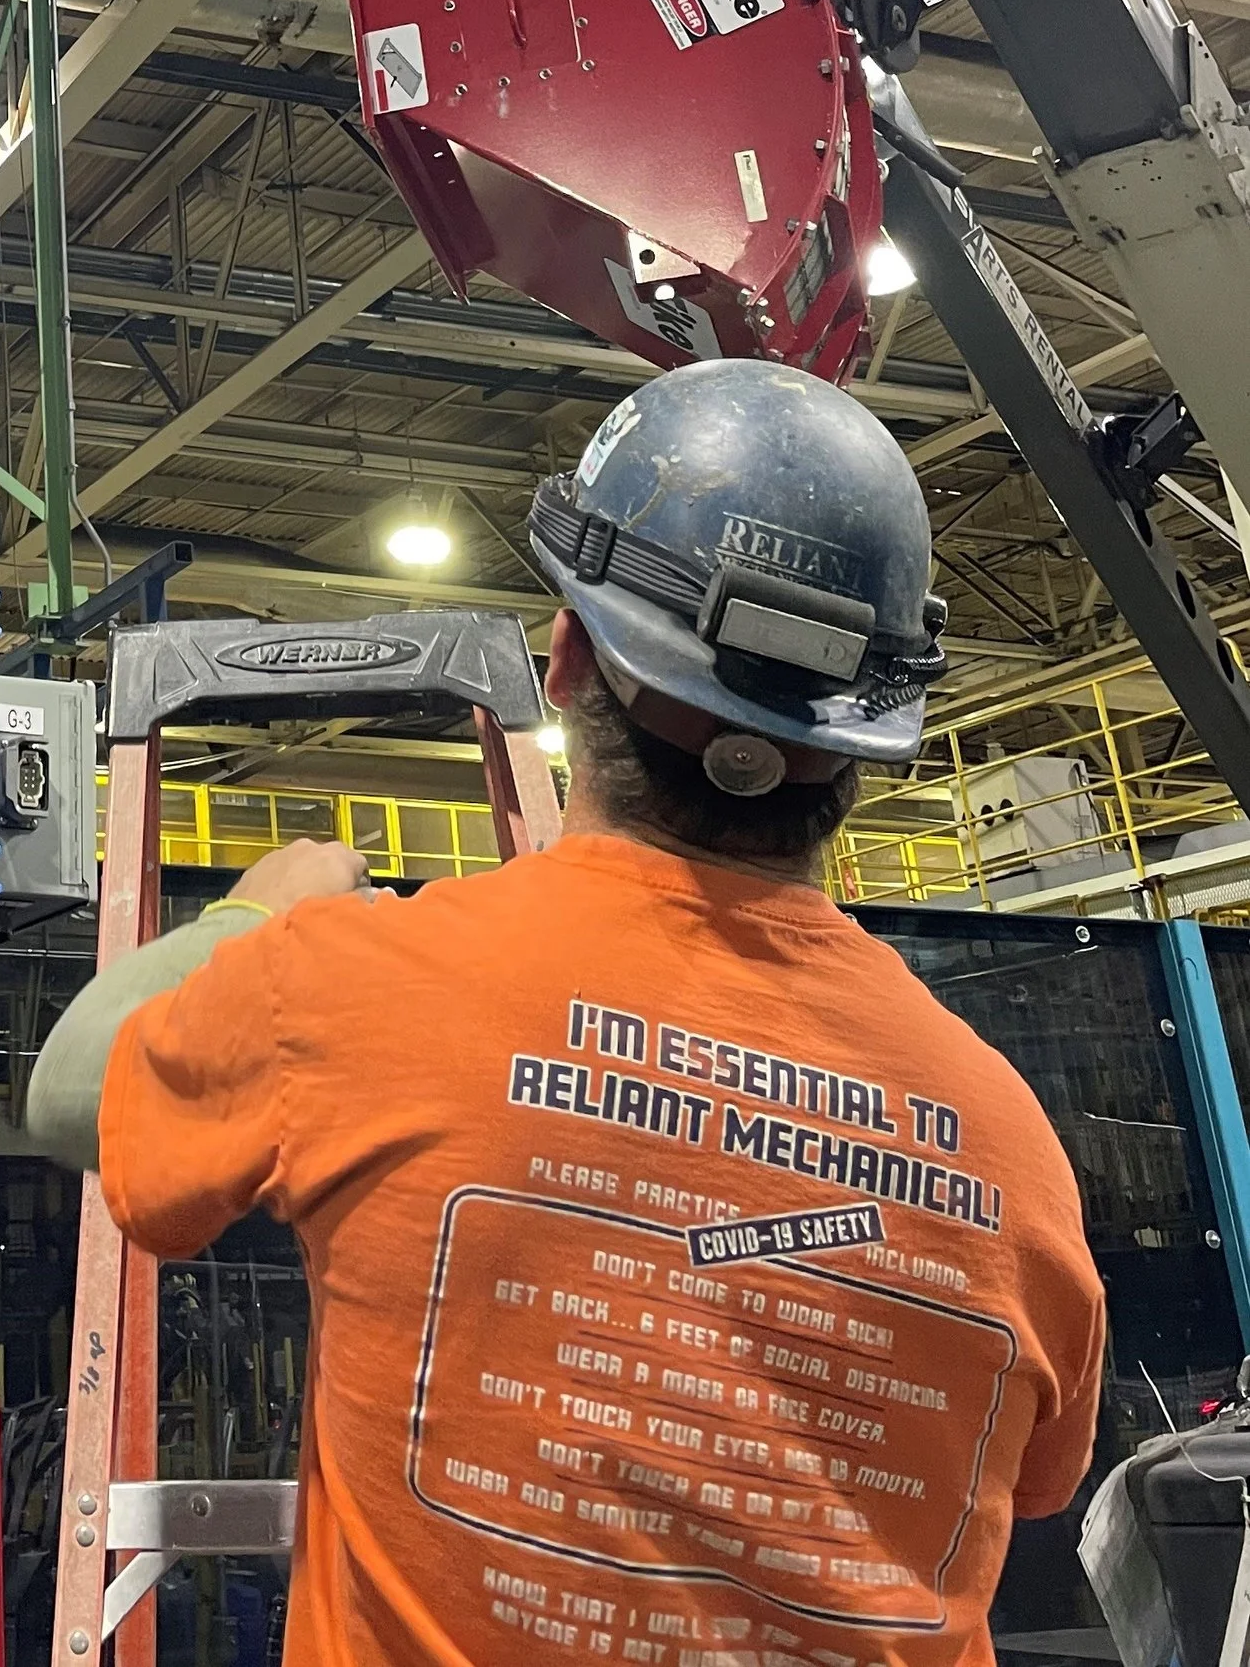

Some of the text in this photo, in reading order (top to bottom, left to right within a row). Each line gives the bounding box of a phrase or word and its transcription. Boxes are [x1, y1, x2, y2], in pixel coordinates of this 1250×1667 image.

[964, 232, 1088, 424] ART'S RENTAL
[7, 708, 33, 730] G-3
[567, 998, 960, 1155] I'M ESSENTIAL TO
[507, 1053, 1001, 1235] RELIANT MECHANICAL!
[528, 1156, 620, 1196] PLEASE
[699, 1210, 872, 1262] COVID-19 SAFETY
[495, 1278, 540, 1307] GET
[666, 1317, 721, 1351] FEET
[729, 1336, 754, 1359] OF
[763, 1343, 831, 1382] SOCIAL
[592, 1249, 657, 1284] DON'T
[667, 1269, 729, 1305] COME
[741, 1288, 766, 1314] TO
[776, 1299, 836, 1334] WORK
[556, 1342, 888, 1445] WEAR A MASK OR FACE COVER.
[480, 1371, 547, 1410] DON'T
[559, 1393, 633, 1432] TOUCH
[646, 1416, 705, 1451] YOUR
[855, 1464, 927, 1500] MOUTH.
[537, 1437, 605, 1475] DON'T
[618, 1459, 690, 1498] TOUCH
[700, 1482, 735, 1510] ME
[445, 1456, 509, 1496] WASH
[520, 1481, 565, 1513] AND
[576, 1498, 674, 1535] SANITIZE
[482, 1565, 547, 1607] KNOW
[560, 1590, 617, 1625] THAT
[628, 1608, 638, 1628] I
[491, 1599, 579, 1647] ANYONE
[589, 1629, 613, 1655] IS
[621, 1637, 667, 1664] NOT
